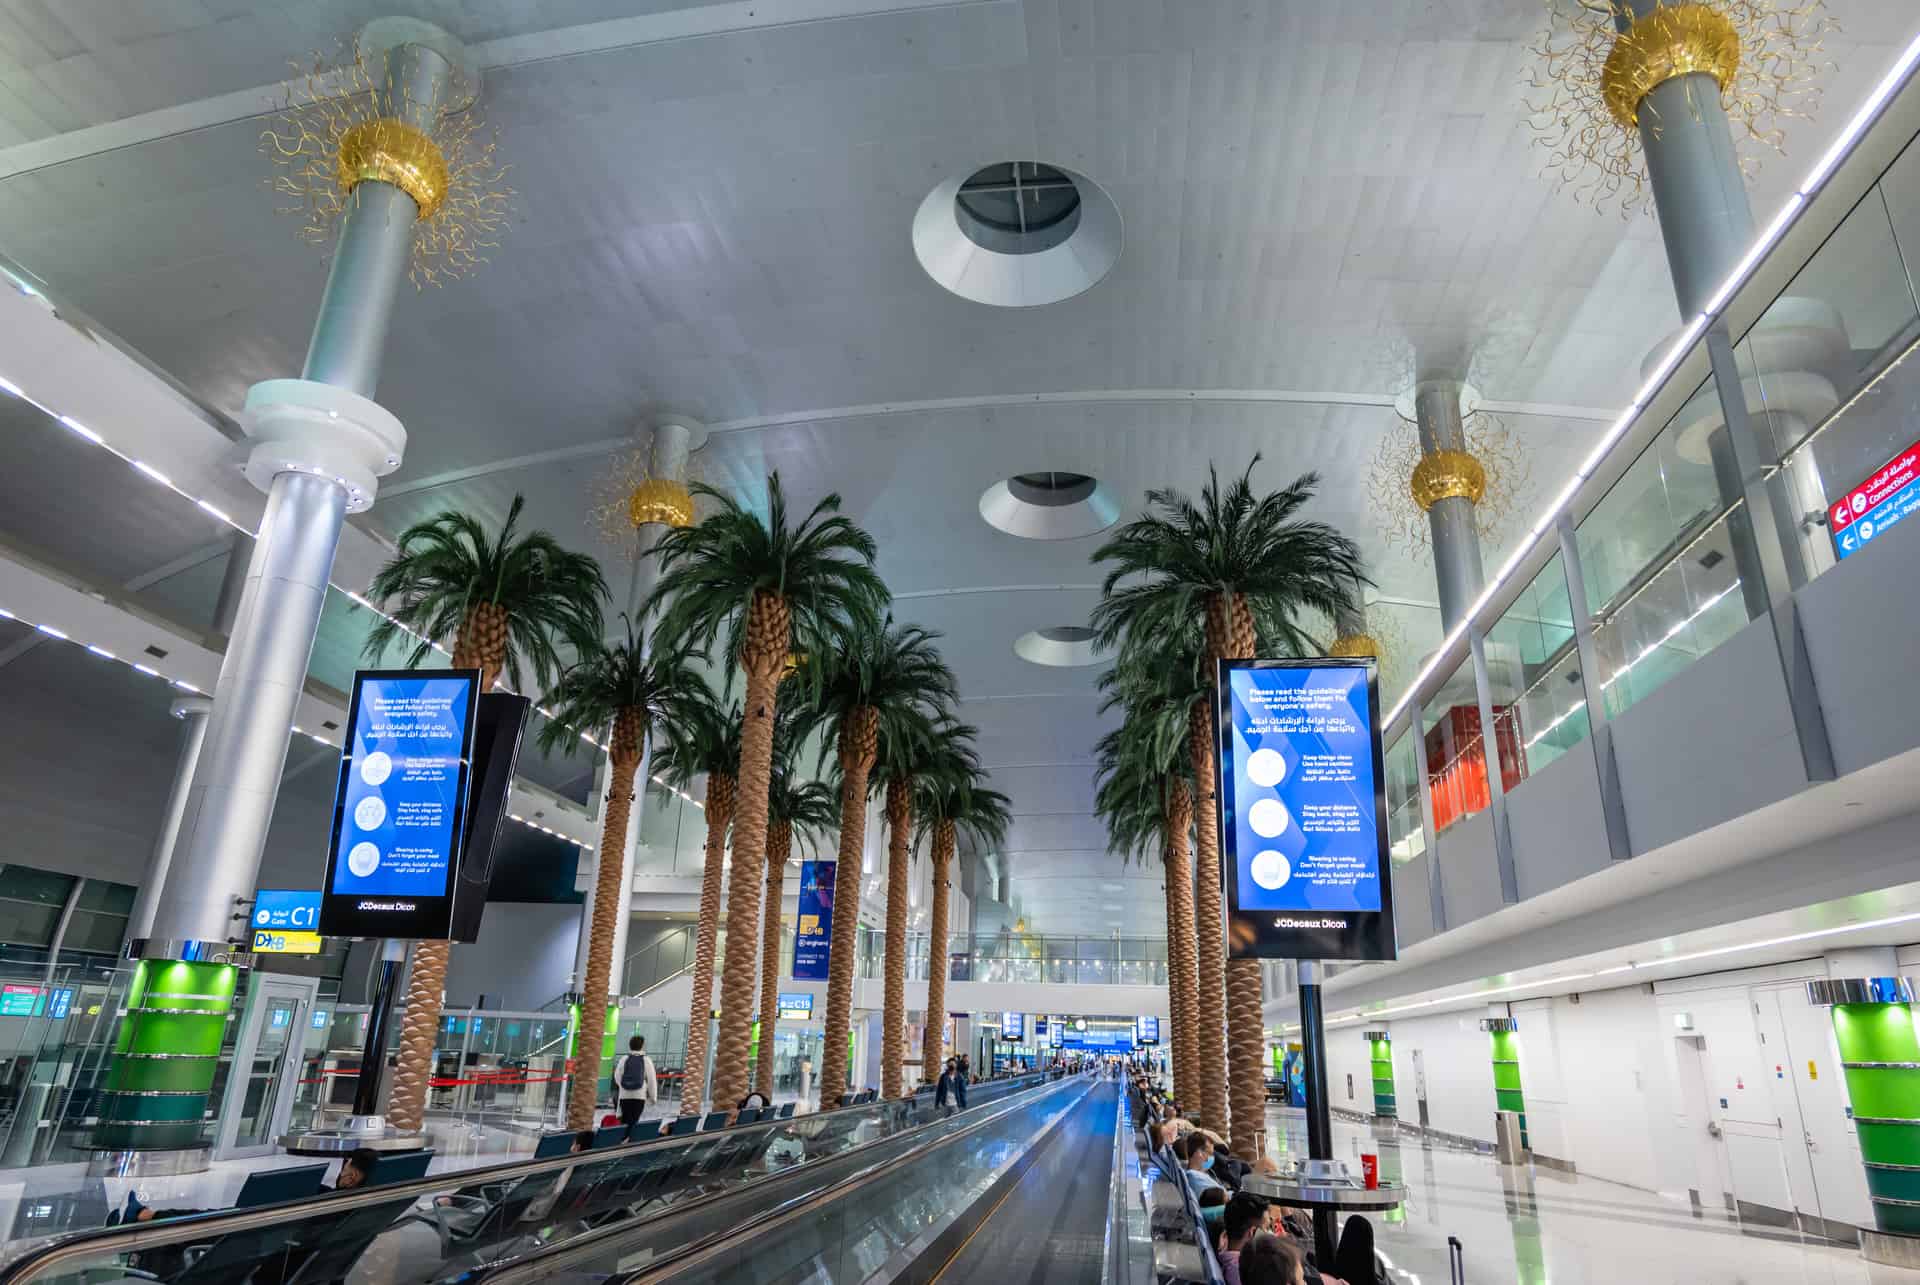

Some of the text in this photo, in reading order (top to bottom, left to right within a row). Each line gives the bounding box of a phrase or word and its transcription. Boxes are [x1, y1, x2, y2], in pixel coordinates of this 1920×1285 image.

[1869, 470, 1914, 505] Connections
[1249, 688, 1274, 696] Please
[1308, 687, 1346, 696] guidelines
[291, 906, 320, 926] C1
[1274, 918, 1347, 928] JCDecaux Dicon
